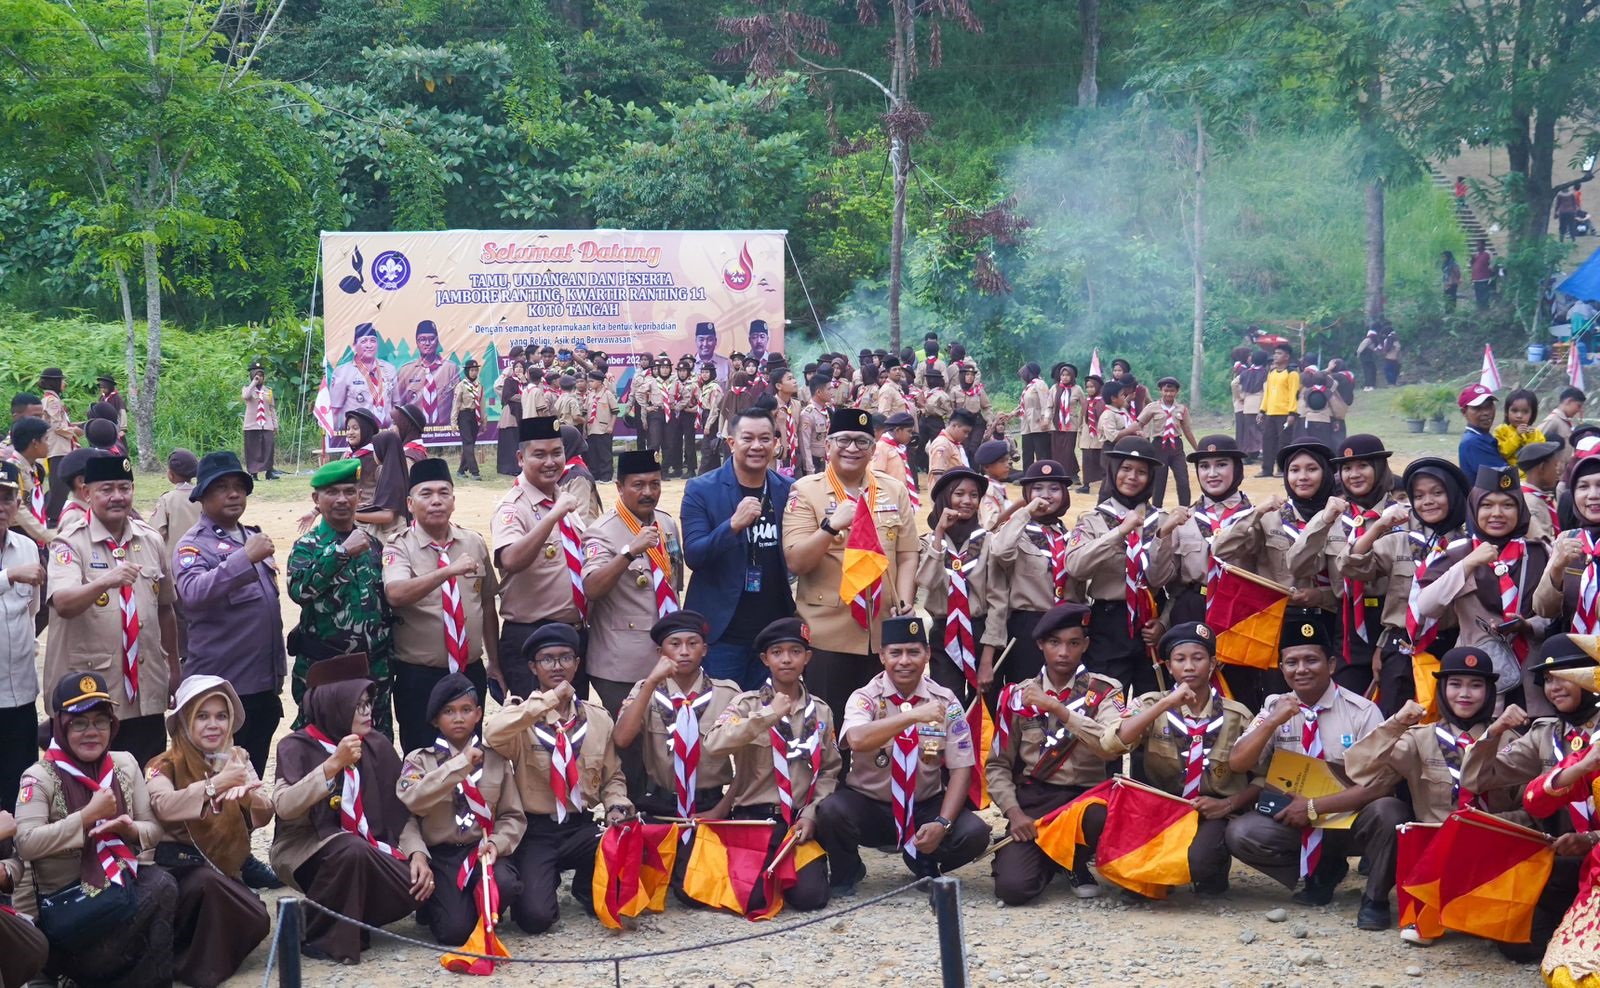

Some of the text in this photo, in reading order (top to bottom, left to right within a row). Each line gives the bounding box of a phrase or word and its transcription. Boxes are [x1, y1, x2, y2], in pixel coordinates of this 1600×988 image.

[480, 240, 662, 268] Selamat Datang
[470, 272, 674, 288] TAMU, UNDANGAN DAN PESERTA
[436, 287, 707, 307] JAMBORE RANTING, KWARTIR RANTING 11
[528, 302, 620, 317] KOTO TANGAH
[475, 324, 503, 335] Dengan
[505, 323, 541, 334] semangat
[542, 323, 591, 333] kepramukaan
[592, 322, 606, 331] kita
[634, 322, 677, 332] kepribadian
[510, 338, 528, 347] yang
[554, 336, 569, 345] Asik
[571, 336, 585, 344] dan
[586, 336, 632, 344] Berwawasan
[626, 355, 641, 365] 202
